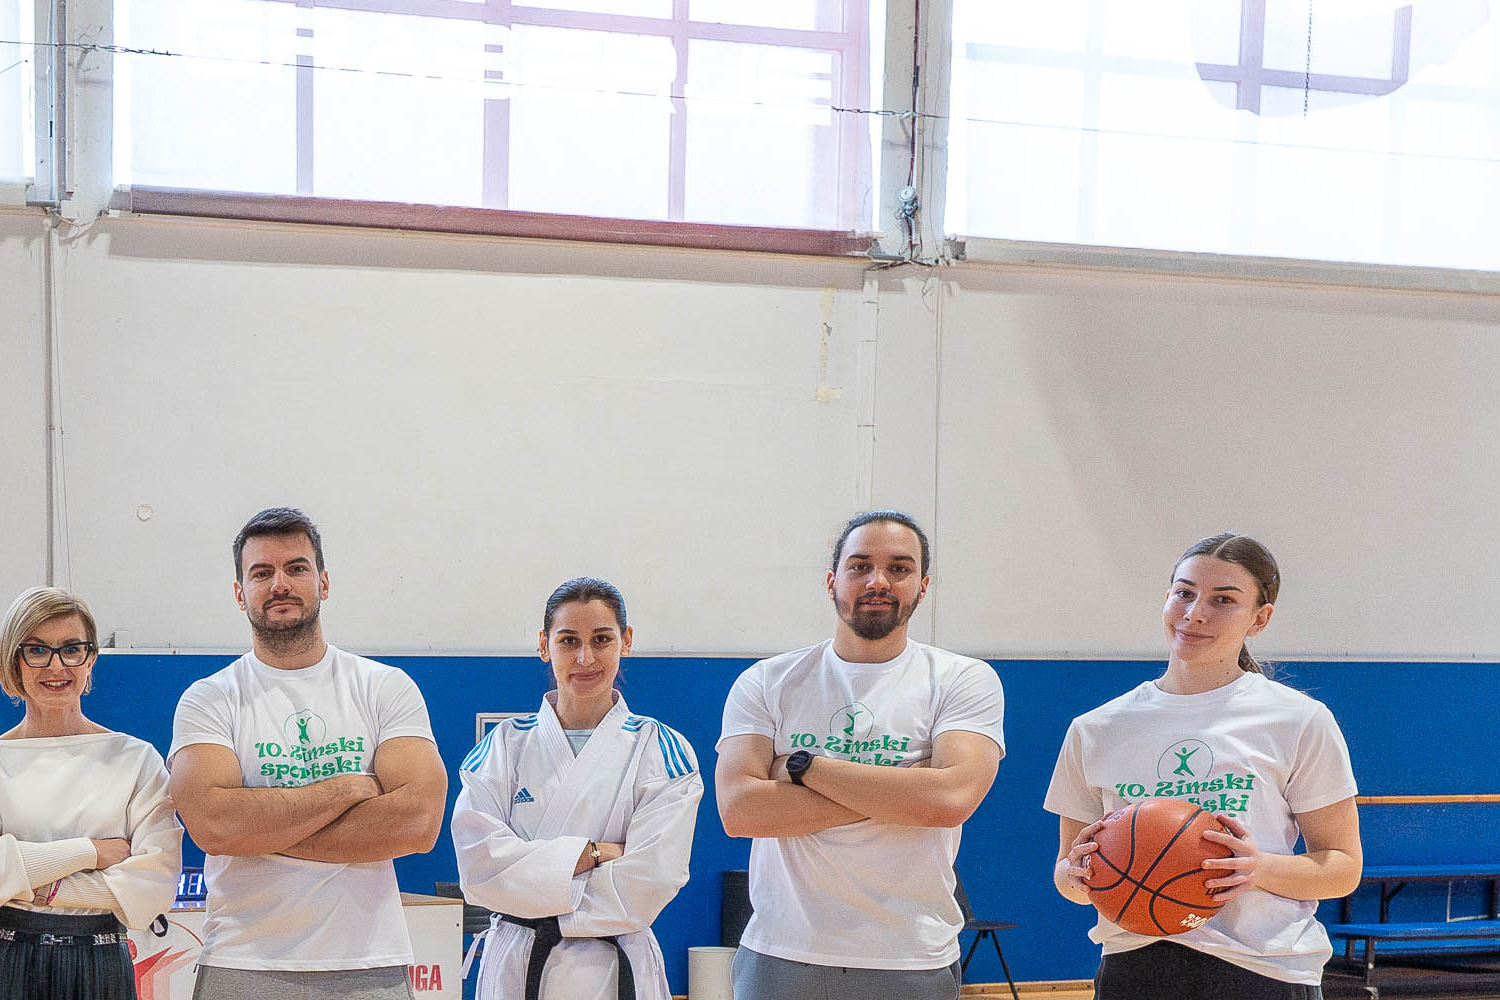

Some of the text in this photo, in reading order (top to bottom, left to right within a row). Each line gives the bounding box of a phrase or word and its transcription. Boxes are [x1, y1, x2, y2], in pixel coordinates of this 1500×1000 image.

[790, 732, 821, 748] 10.
[254, 742, 287, 758] 10.
[1115, 772, 1256, 797] 10. Zimski
